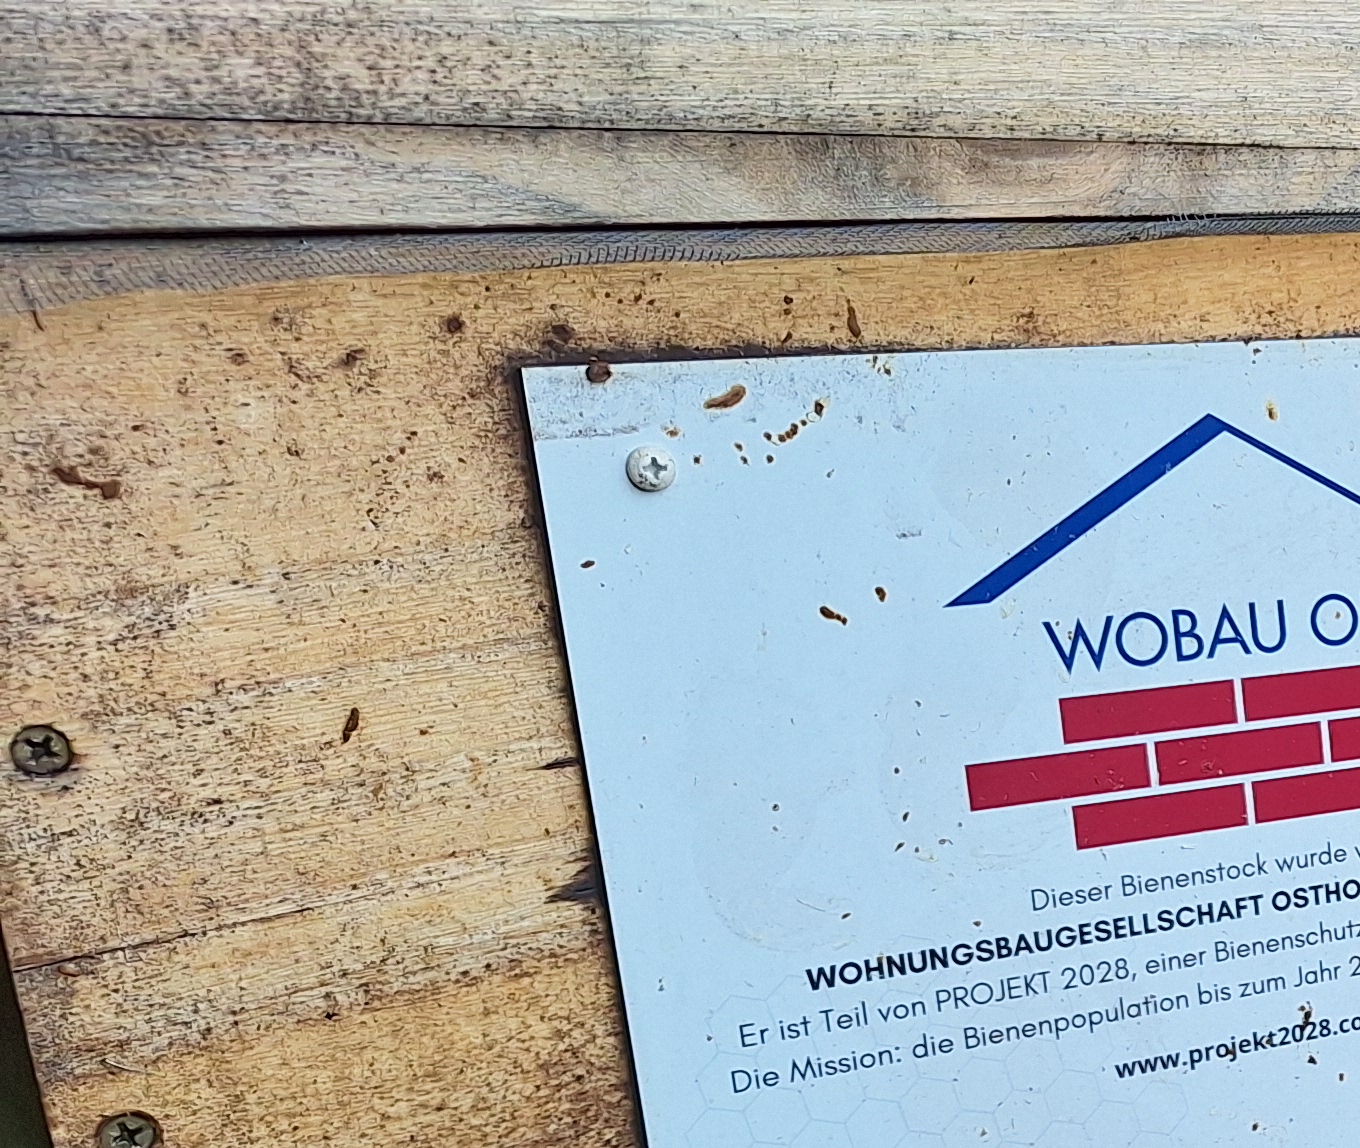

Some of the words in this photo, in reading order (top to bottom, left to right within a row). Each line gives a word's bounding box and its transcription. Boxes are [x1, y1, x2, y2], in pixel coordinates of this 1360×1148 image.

[1042, 599, 1287, 675] WOBAU
[1031, 884, 1112, 911] Dieser
[1121, 853, 1268, 897] Bienenstock
[1276, 842, 1347, 873] wurde
[806, 895, 1263, 991] WOHNUNGSBAUGESELLSCHAFT
[731, 1067, 781, 1094] Die
[790, 1044, 902, 1083] Mission:
[912, 1031, 955, 1059] die
[963, 992, 1190, 1050] Bienenpopulation
[1198, 979, 1232, 1005] bis
[1238, 977, 1287, 998] zum
[1293, 964, 1341, 988] Jahr
[738, 1024, 769, 1047] Er
[780, 1015, 811, 1041] ist
[820, 1002, 868, 1034] Teil
[878, 1001, 927, 1024] von
[935, 971, 1052, 1013] PROJEKT
[1062, 959, 1138, 991] 2028,
[1145, 949, 1208, 976] einer
